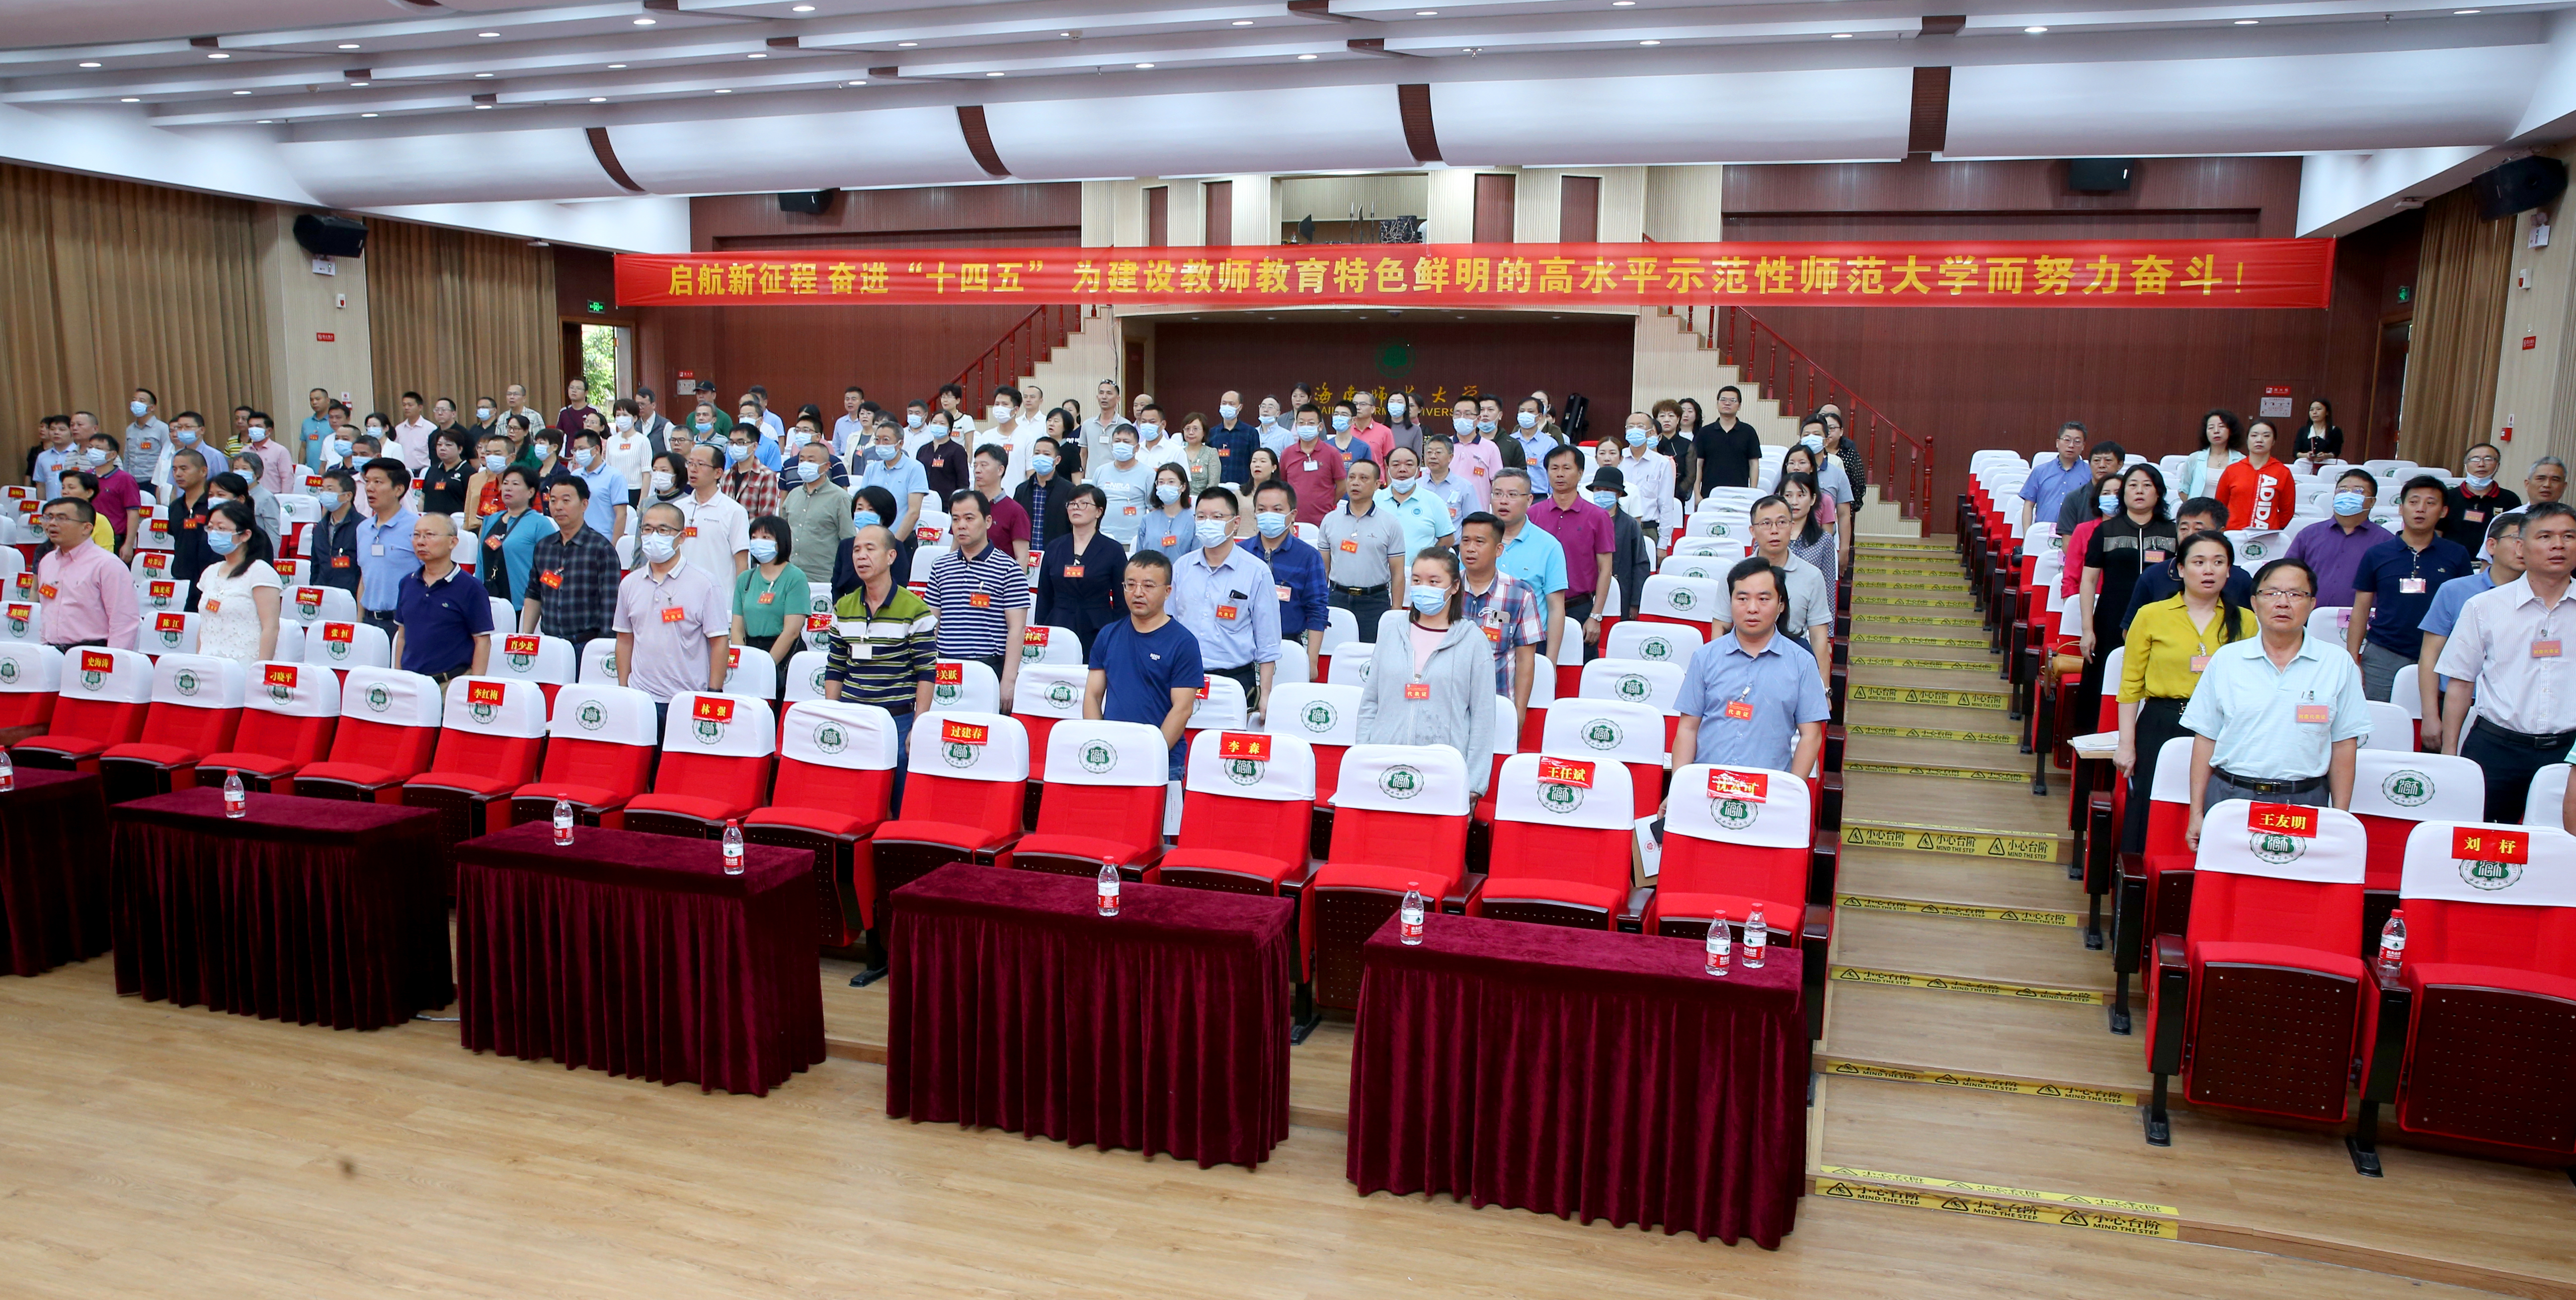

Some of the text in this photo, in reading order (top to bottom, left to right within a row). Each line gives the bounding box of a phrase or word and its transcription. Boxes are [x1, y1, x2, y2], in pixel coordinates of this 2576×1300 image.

[2255, 474, 2277, 529] ADIDA
[511, 640, 534, 651] 肖少北
[87, 656, 109, 668] 史海涛
[474, 688, 499, 701] 李红梅
[1868, 687, 1896, 697] 小心台阶
[1920, 691, 1949, 700] 小心台阶
[1972, 694, 2002, 704] 小心台阶
[701, 703, 726, 717] 林强
[1728, 709, 1749, 718] 代表证
[951, 726, 982, 740] 过建春
[1227, 740, 1260, 755] 李森
[1547, 766, 1587, 782] 王任斌
[2259, 813, 2307, 830] 王友明
[1866, 829, 1905, 841] 小心台阶
[1936, 834, 1976, 847] 小心台阶
[2008, 839, 2048, 854] 小心台阶
